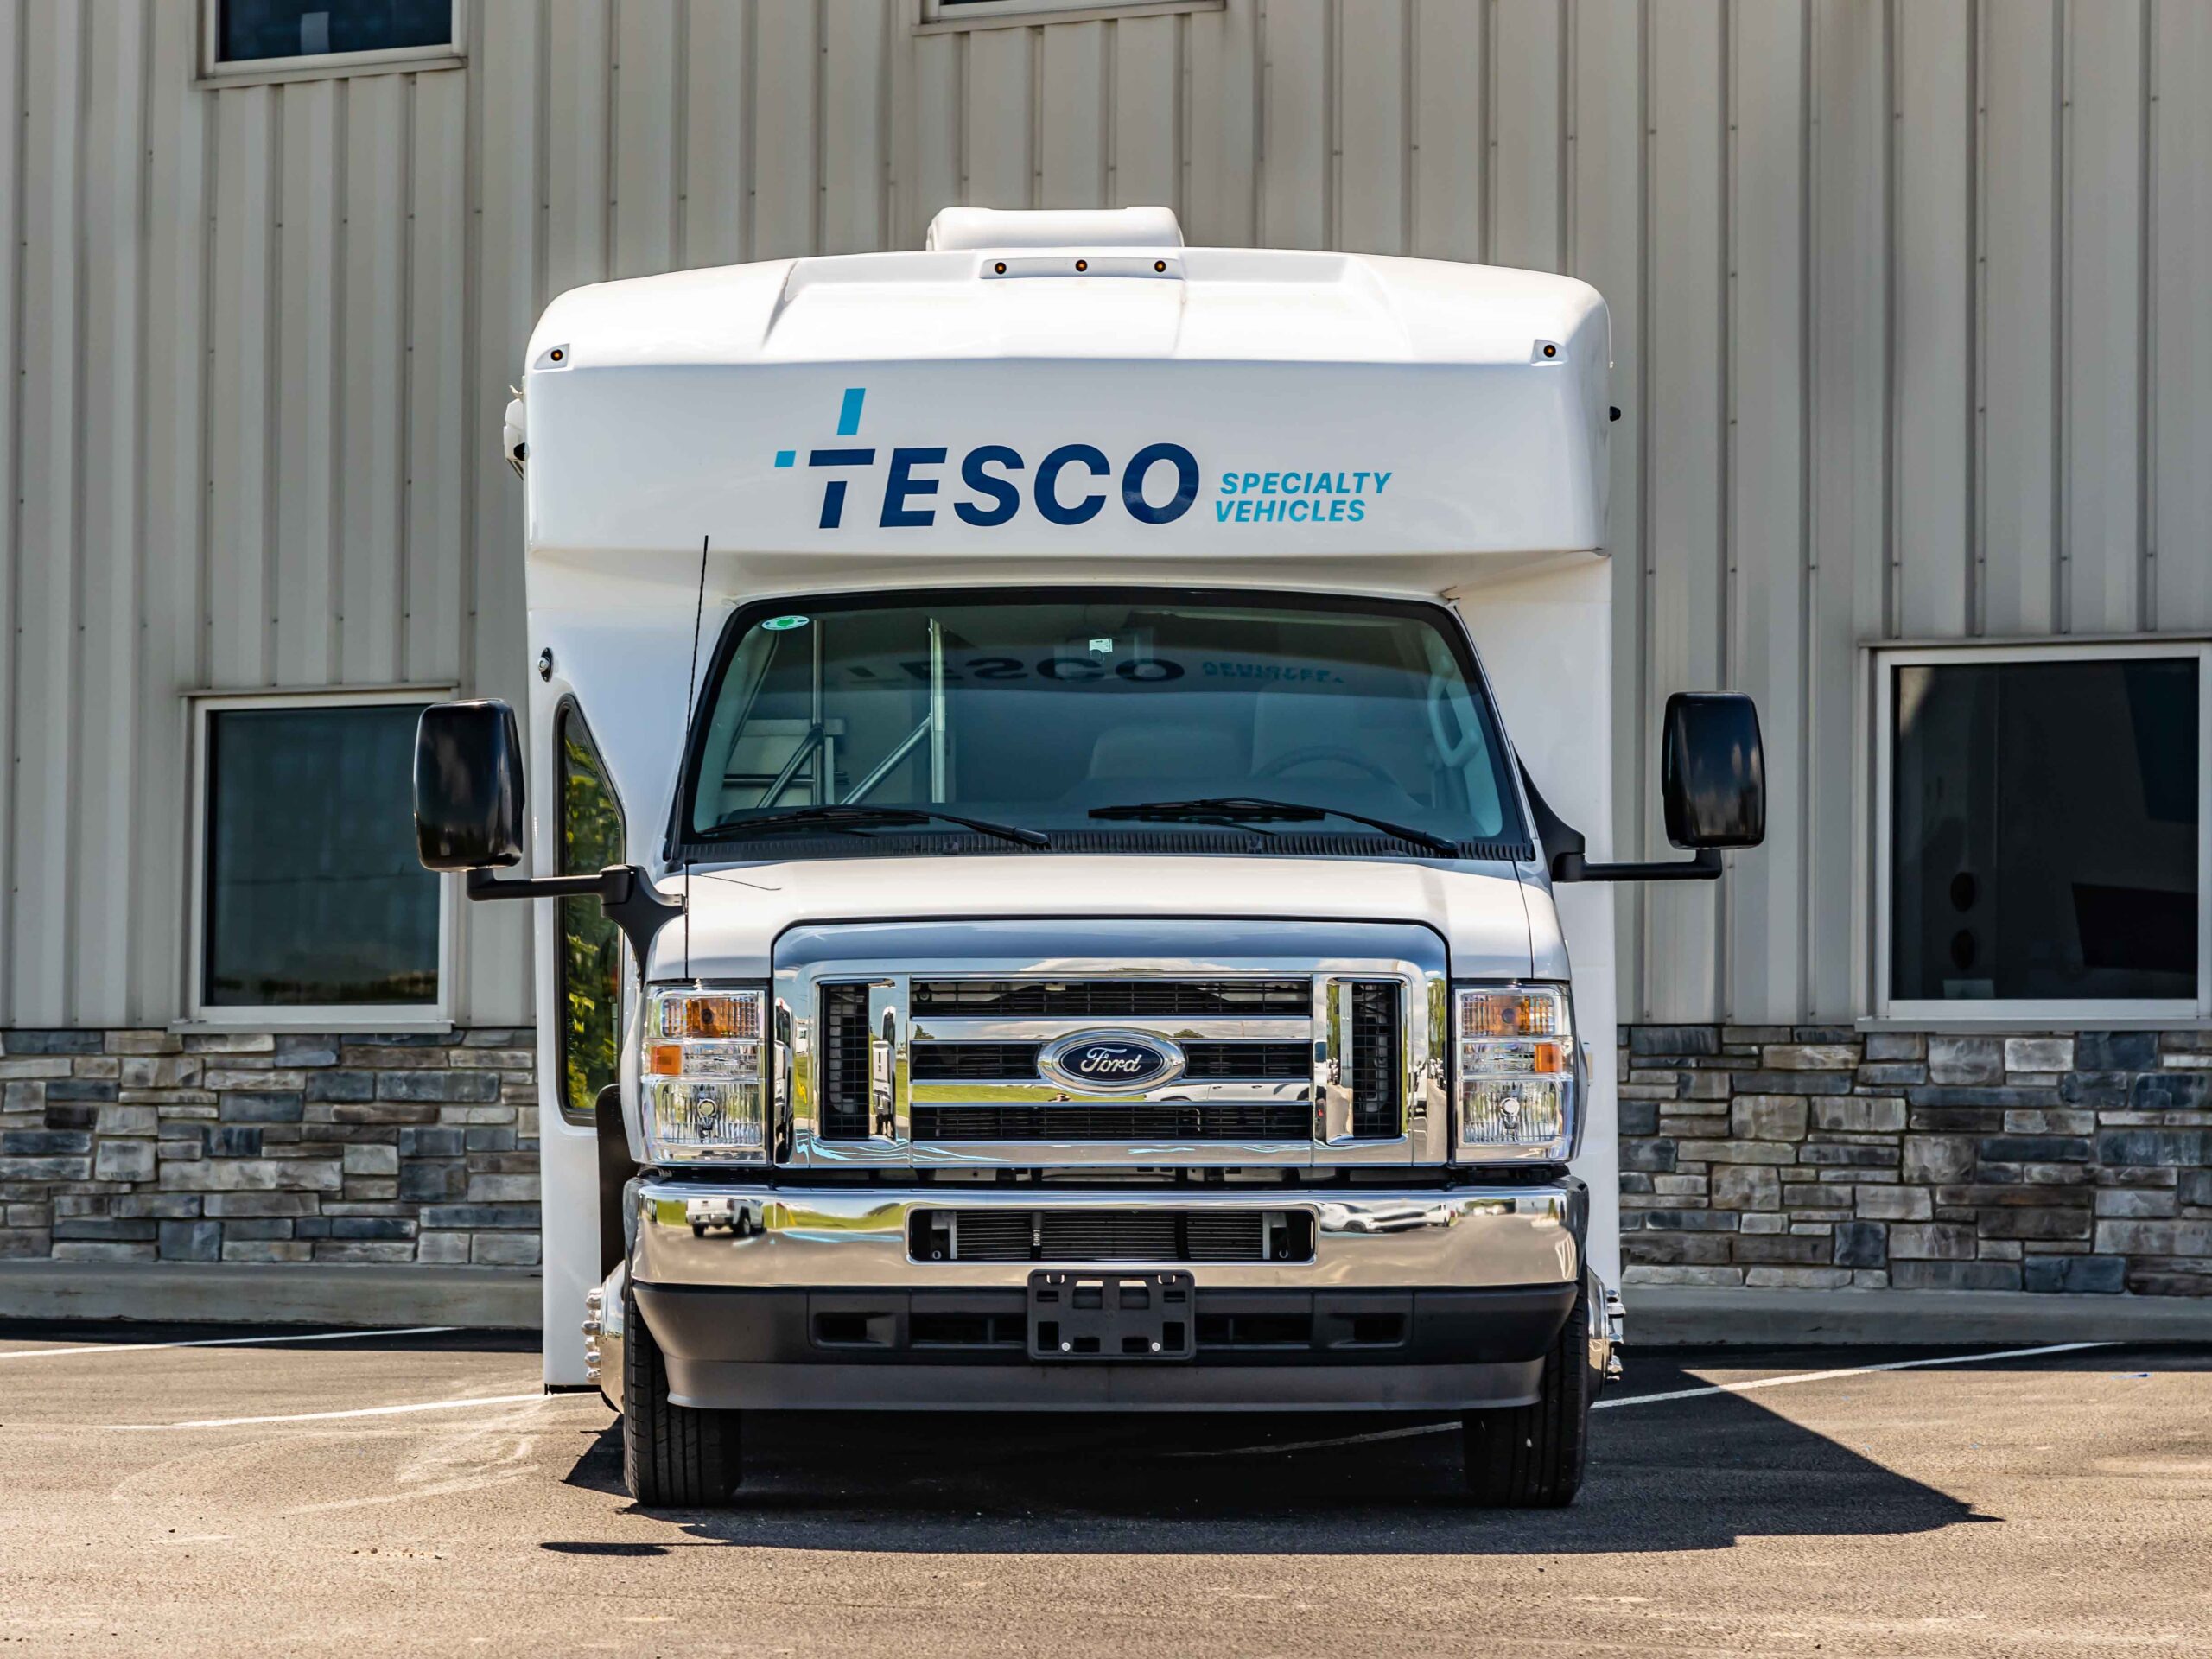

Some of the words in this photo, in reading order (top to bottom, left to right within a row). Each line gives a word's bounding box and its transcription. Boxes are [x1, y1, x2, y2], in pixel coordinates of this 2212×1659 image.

[808, 388, 1200, 530] TESCO
[1220, 472, 1392, 495] SPECIALTY
[1215, 499, 1367, 523] VEHICLES
[1080, 1046, 1143, 1073] Ford
